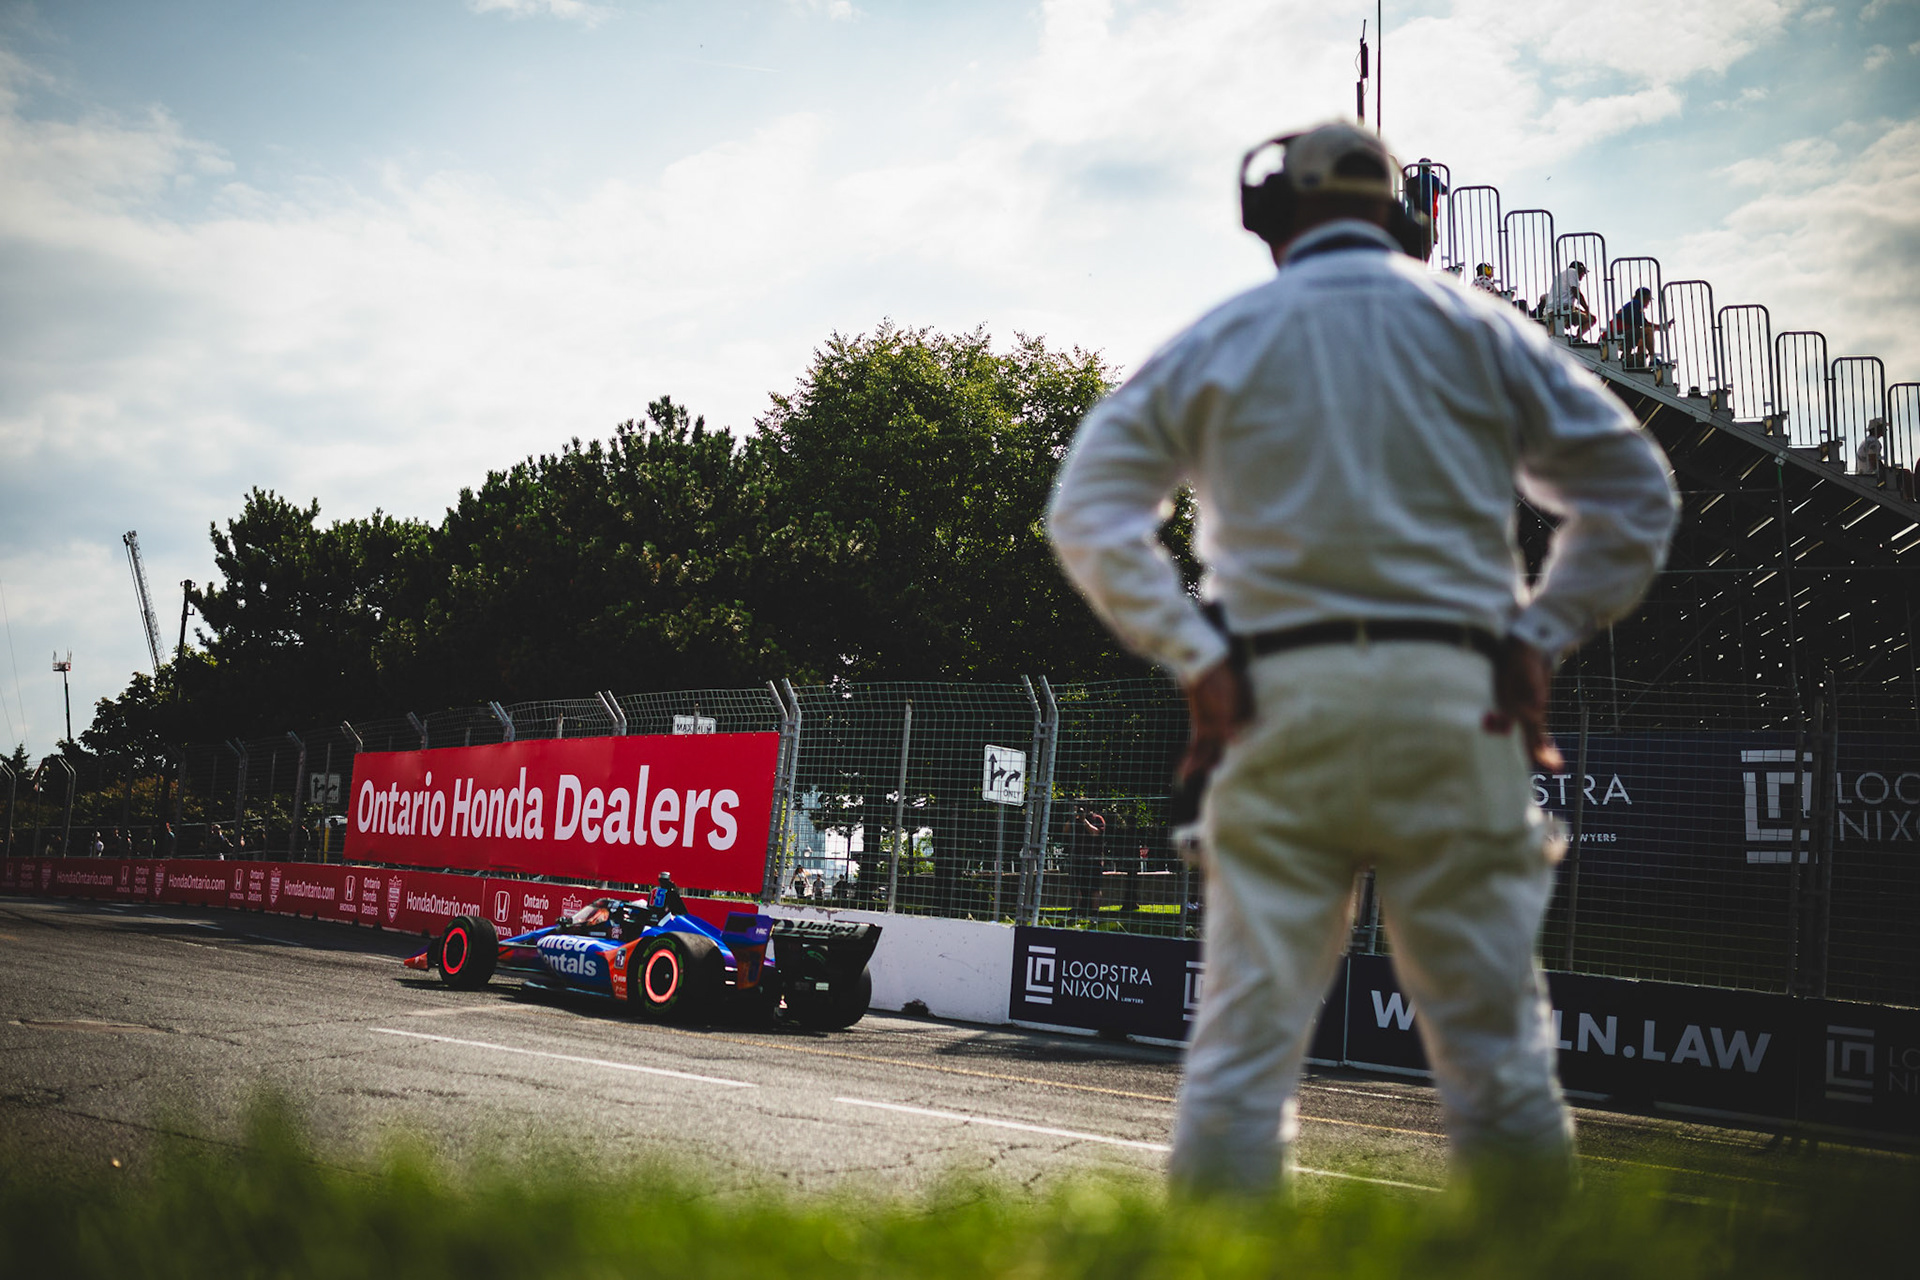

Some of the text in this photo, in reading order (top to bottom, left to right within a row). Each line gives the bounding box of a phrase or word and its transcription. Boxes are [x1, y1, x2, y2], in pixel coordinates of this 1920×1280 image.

[357, 764, 740, 851] Ontario Honda Dealers
[57, 871, 113, 886] HondaOntario.com
[168, 874, 226, 891] HondaOntario.com
[363, 877, 381, 890] Ontario
[284, 879, 335, 901] HondaOntario.com
[362, 889, 377, 903] Honda
[361, 902, 379, 917] Dealers
[406, 890, 481, 918] HondaOntario.com
[524, 893, 549, 910] Ontario
[522, 910, 544, 926] Honda
[797, 920, 858, 935] United
[542, 953, 597, 977] entals
[1061, 960, 1153, 987] LOOPSTRA
[1060, 979, 1120, 1001] NIXON
